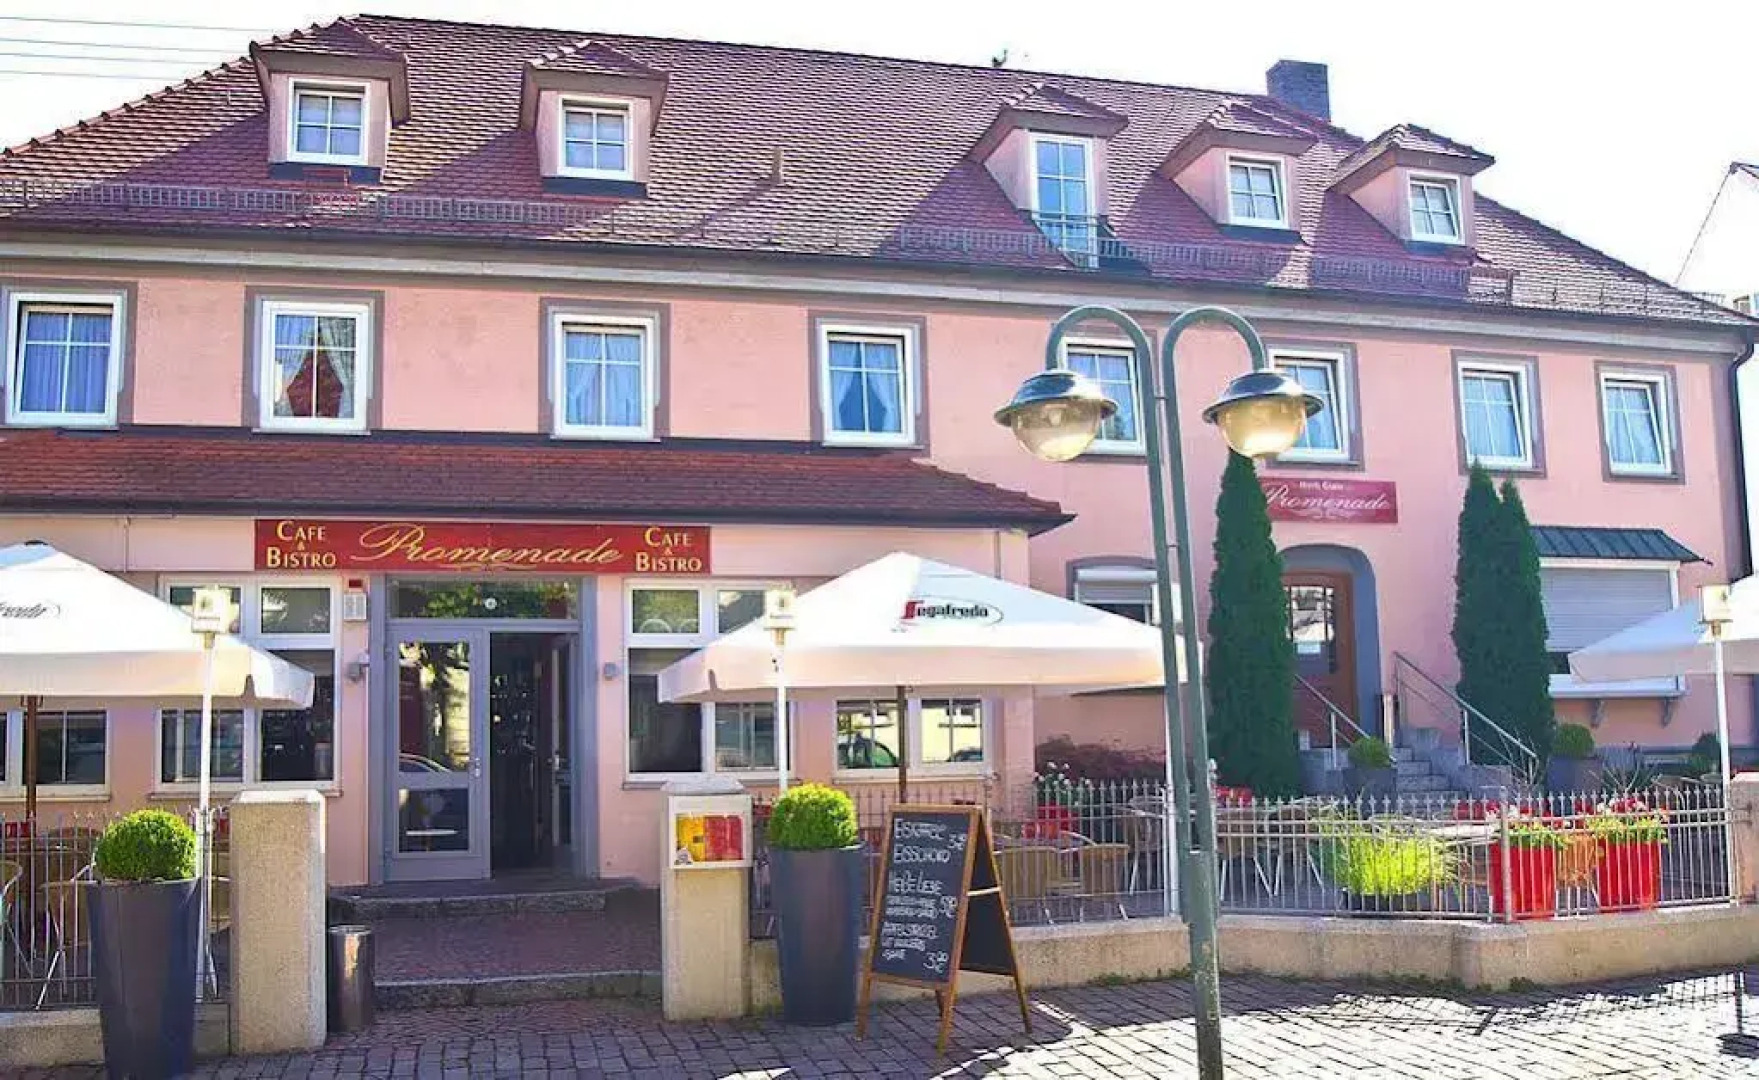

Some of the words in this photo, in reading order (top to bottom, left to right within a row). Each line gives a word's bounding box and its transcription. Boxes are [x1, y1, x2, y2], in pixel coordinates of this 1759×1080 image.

[1265, 484, 1390, 508] Promenade
[351, 522, 623, 563] Promenade
[900, 600, 989, 620] Segafredo
